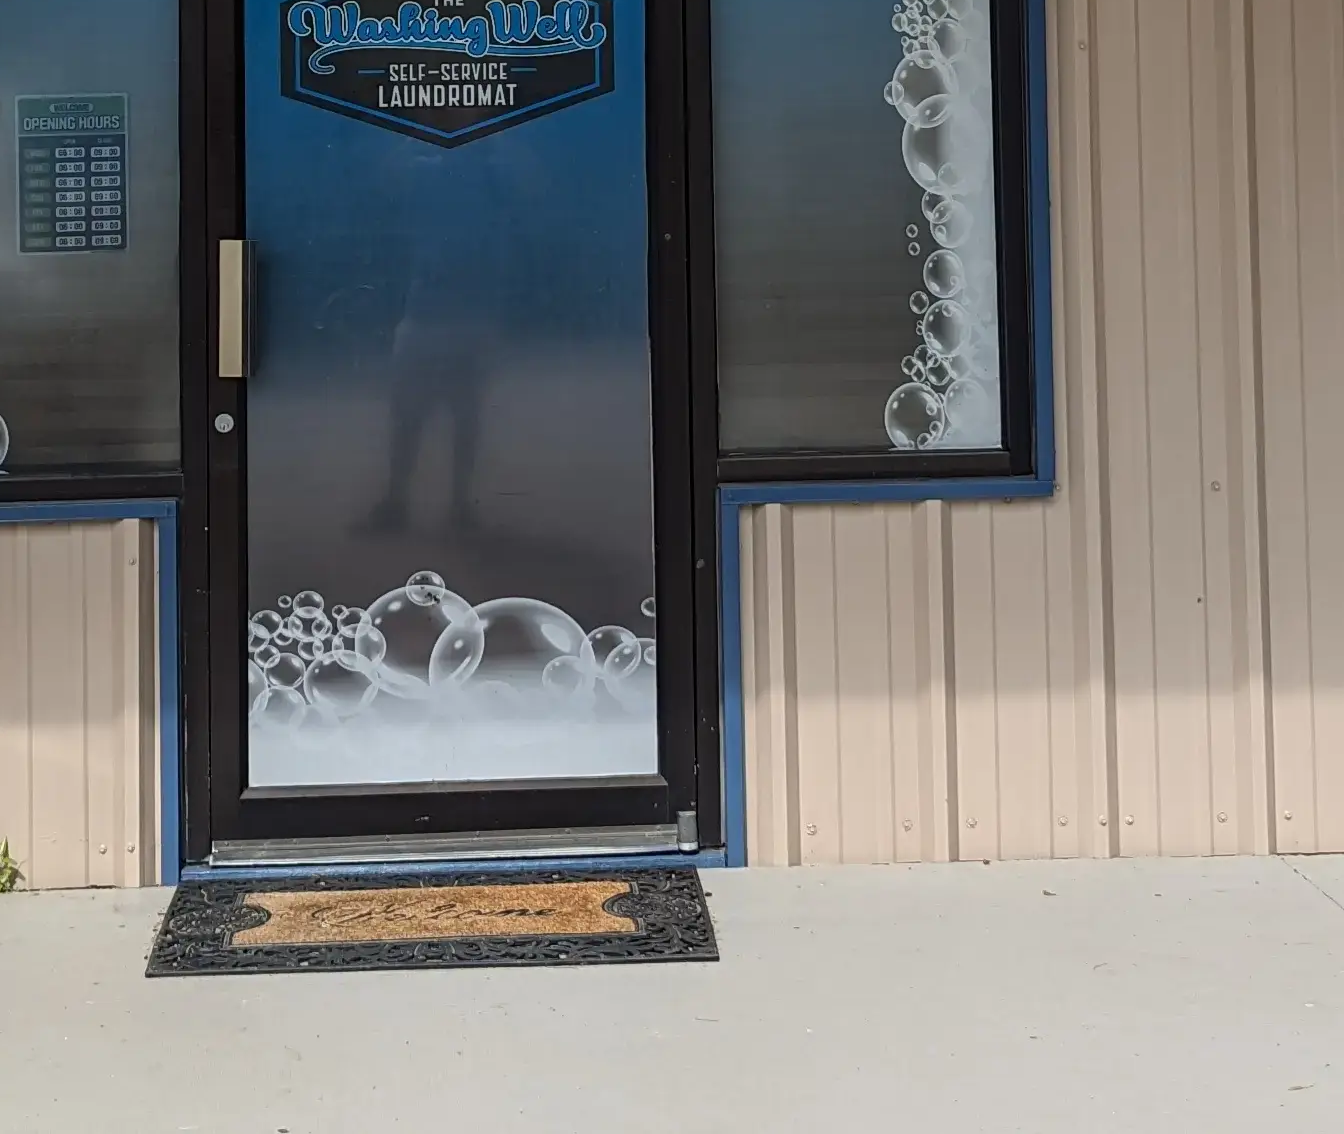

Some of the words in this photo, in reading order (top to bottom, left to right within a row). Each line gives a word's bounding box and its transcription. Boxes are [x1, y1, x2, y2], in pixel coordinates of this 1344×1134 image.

[288, 1, 488, 57] Washing
[389, 62, 508, 82] SELF-SERVICE
[378, 83, 517, 108] LAUNDROMAT
[23, 117, 76, 131] OPENING
[79, 115, 120, 130] HOURS
